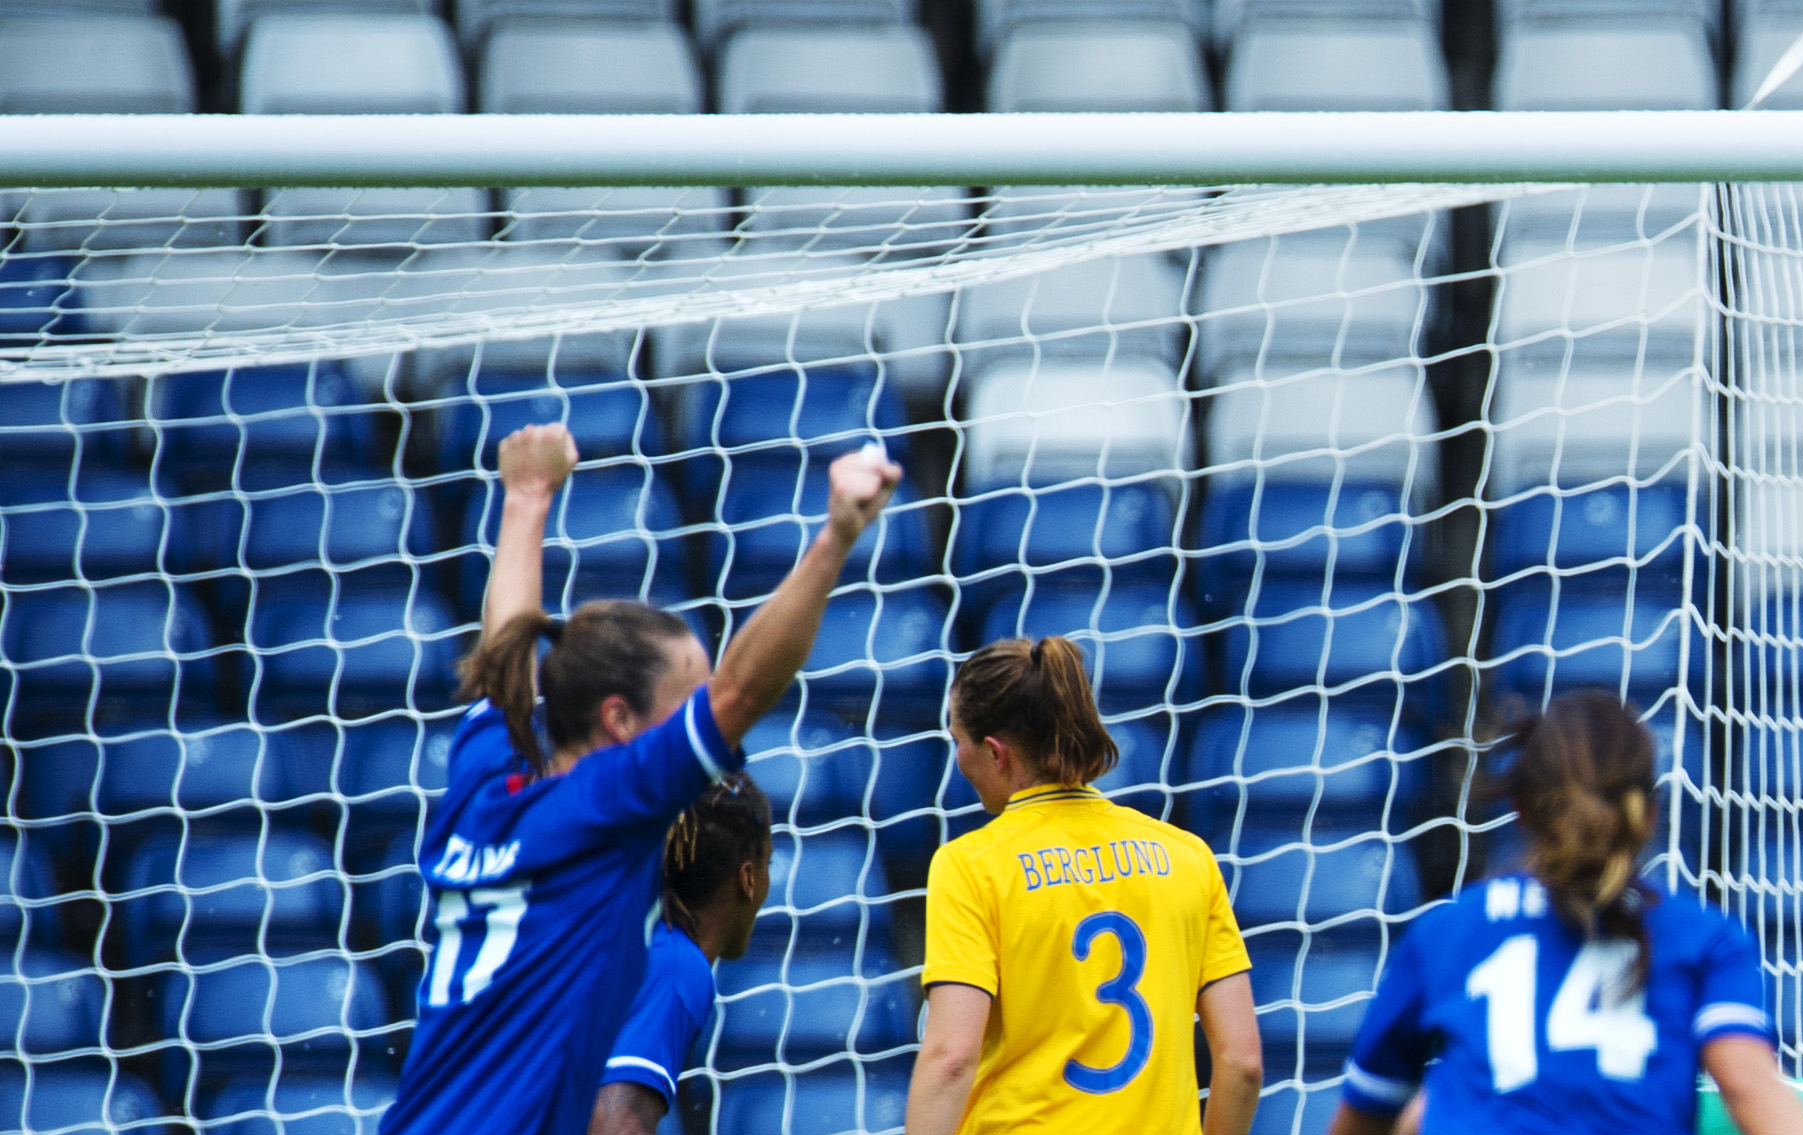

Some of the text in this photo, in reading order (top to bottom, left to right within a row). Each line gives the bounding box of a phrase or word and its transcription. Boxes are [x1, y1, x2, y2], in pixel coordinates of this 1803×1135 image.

[1018, 840, 1171, 891] BERGLUND
[429, 880, 531, 1008] 17
[1062, 910, 1154, 1095] 3
[1465, 933, 1657, 1094] 14
